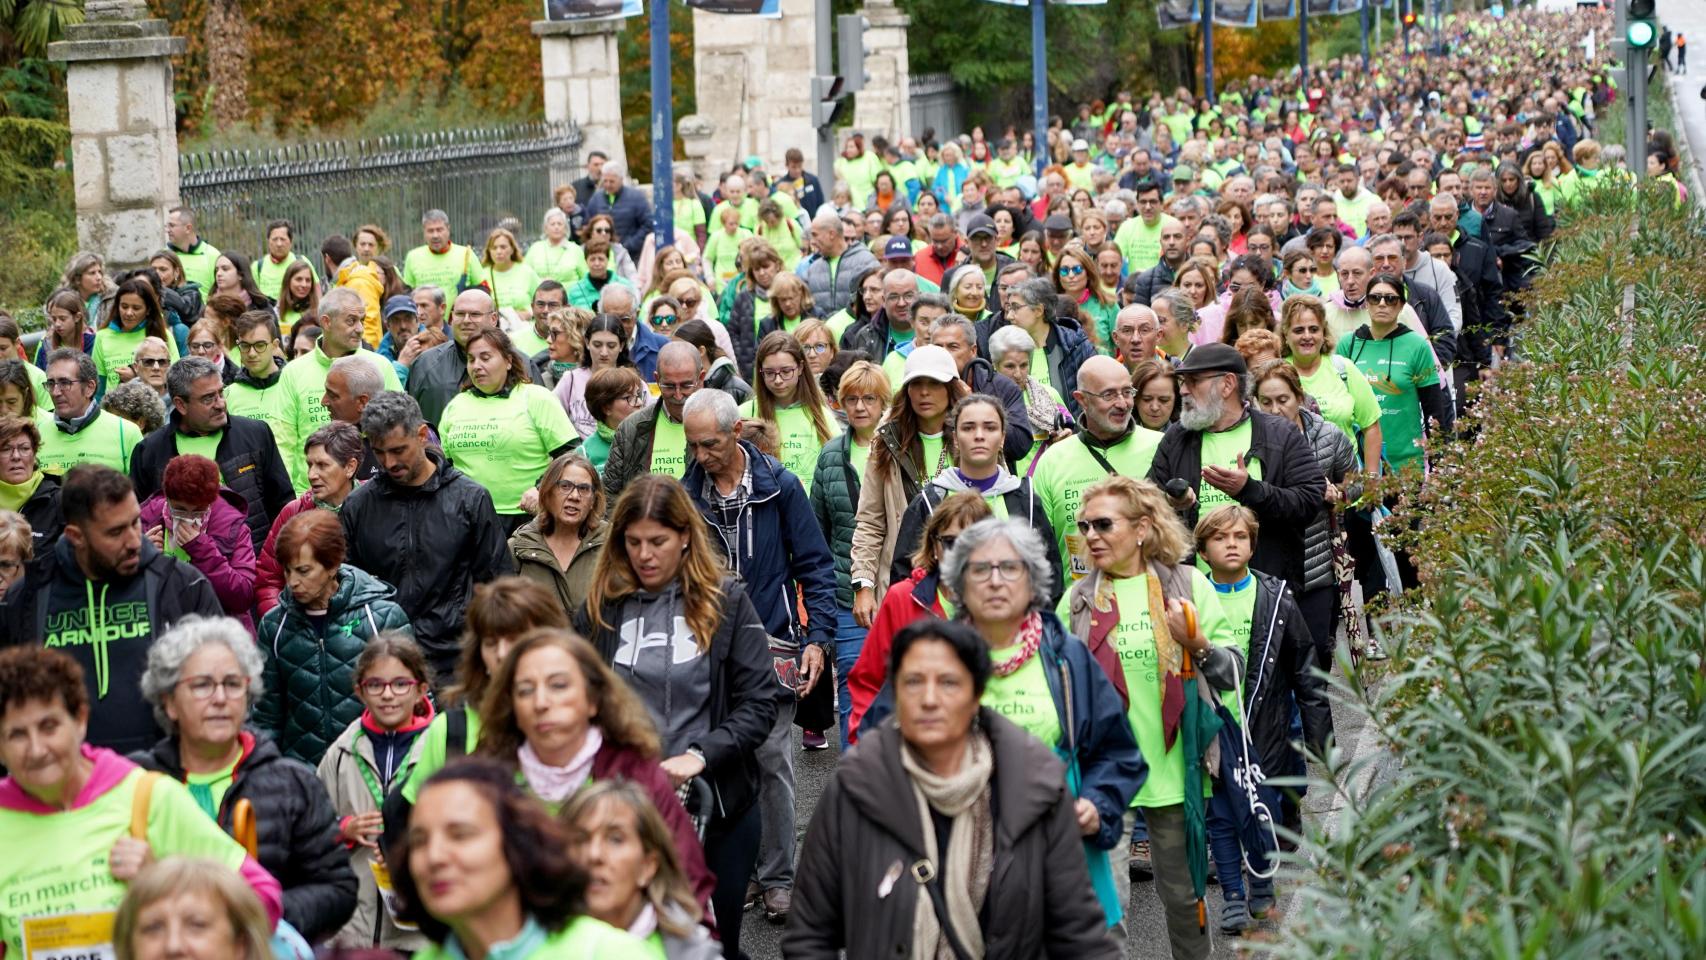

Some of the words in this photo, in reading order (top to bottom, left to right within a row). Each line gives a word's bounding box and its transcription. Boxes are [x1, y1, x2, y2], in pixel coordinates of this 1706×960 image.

[308, 396, 320, 405] En
[308, 406, 327, 414] con
[310, 415, 318, 423] el
[1064, 489, 1079, 500] En
[1066, 513, 1076, 522] el
[9, 892, 30, 908] En
